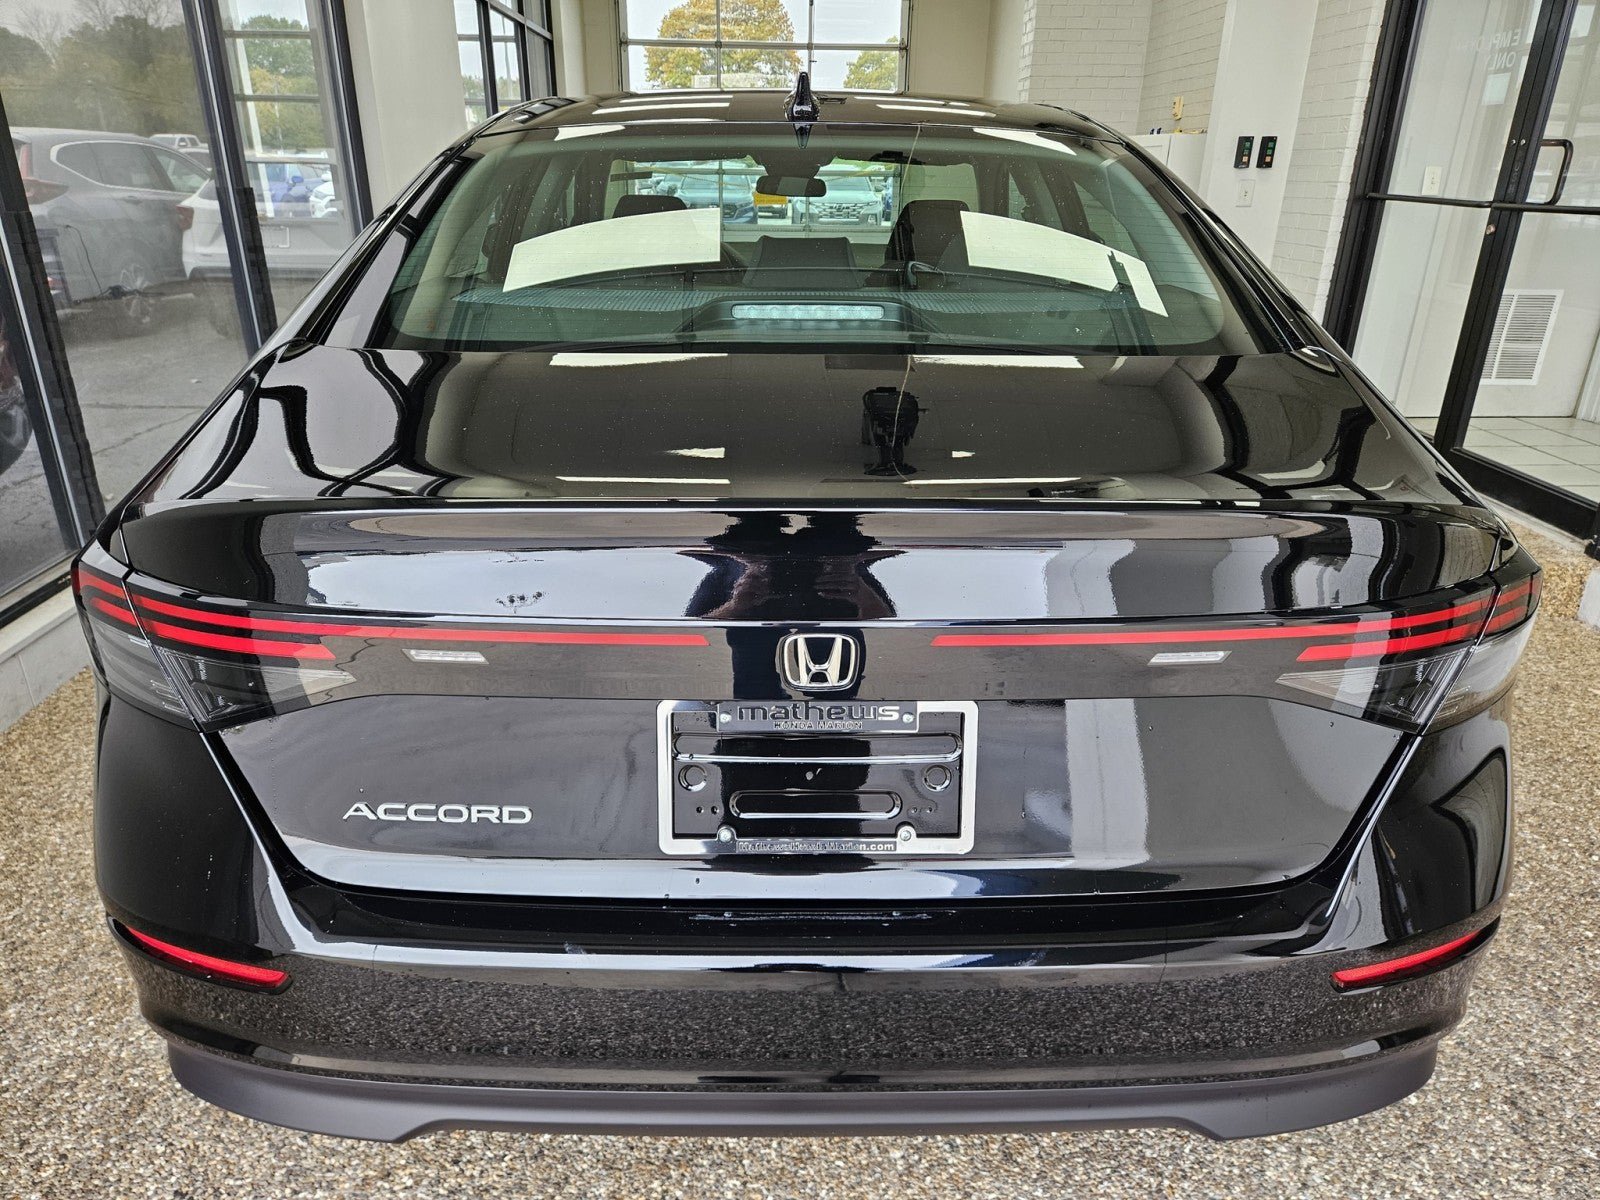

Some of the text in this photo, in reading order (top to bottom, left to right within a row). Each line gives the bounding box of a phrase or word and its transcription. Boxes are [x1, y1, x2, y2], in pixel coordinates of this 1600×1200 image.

[737, 700, 900, 721] mathews
[774, 721, 863, 730] HONDA MARION
[342, 802, 533, 824] ACCORD
